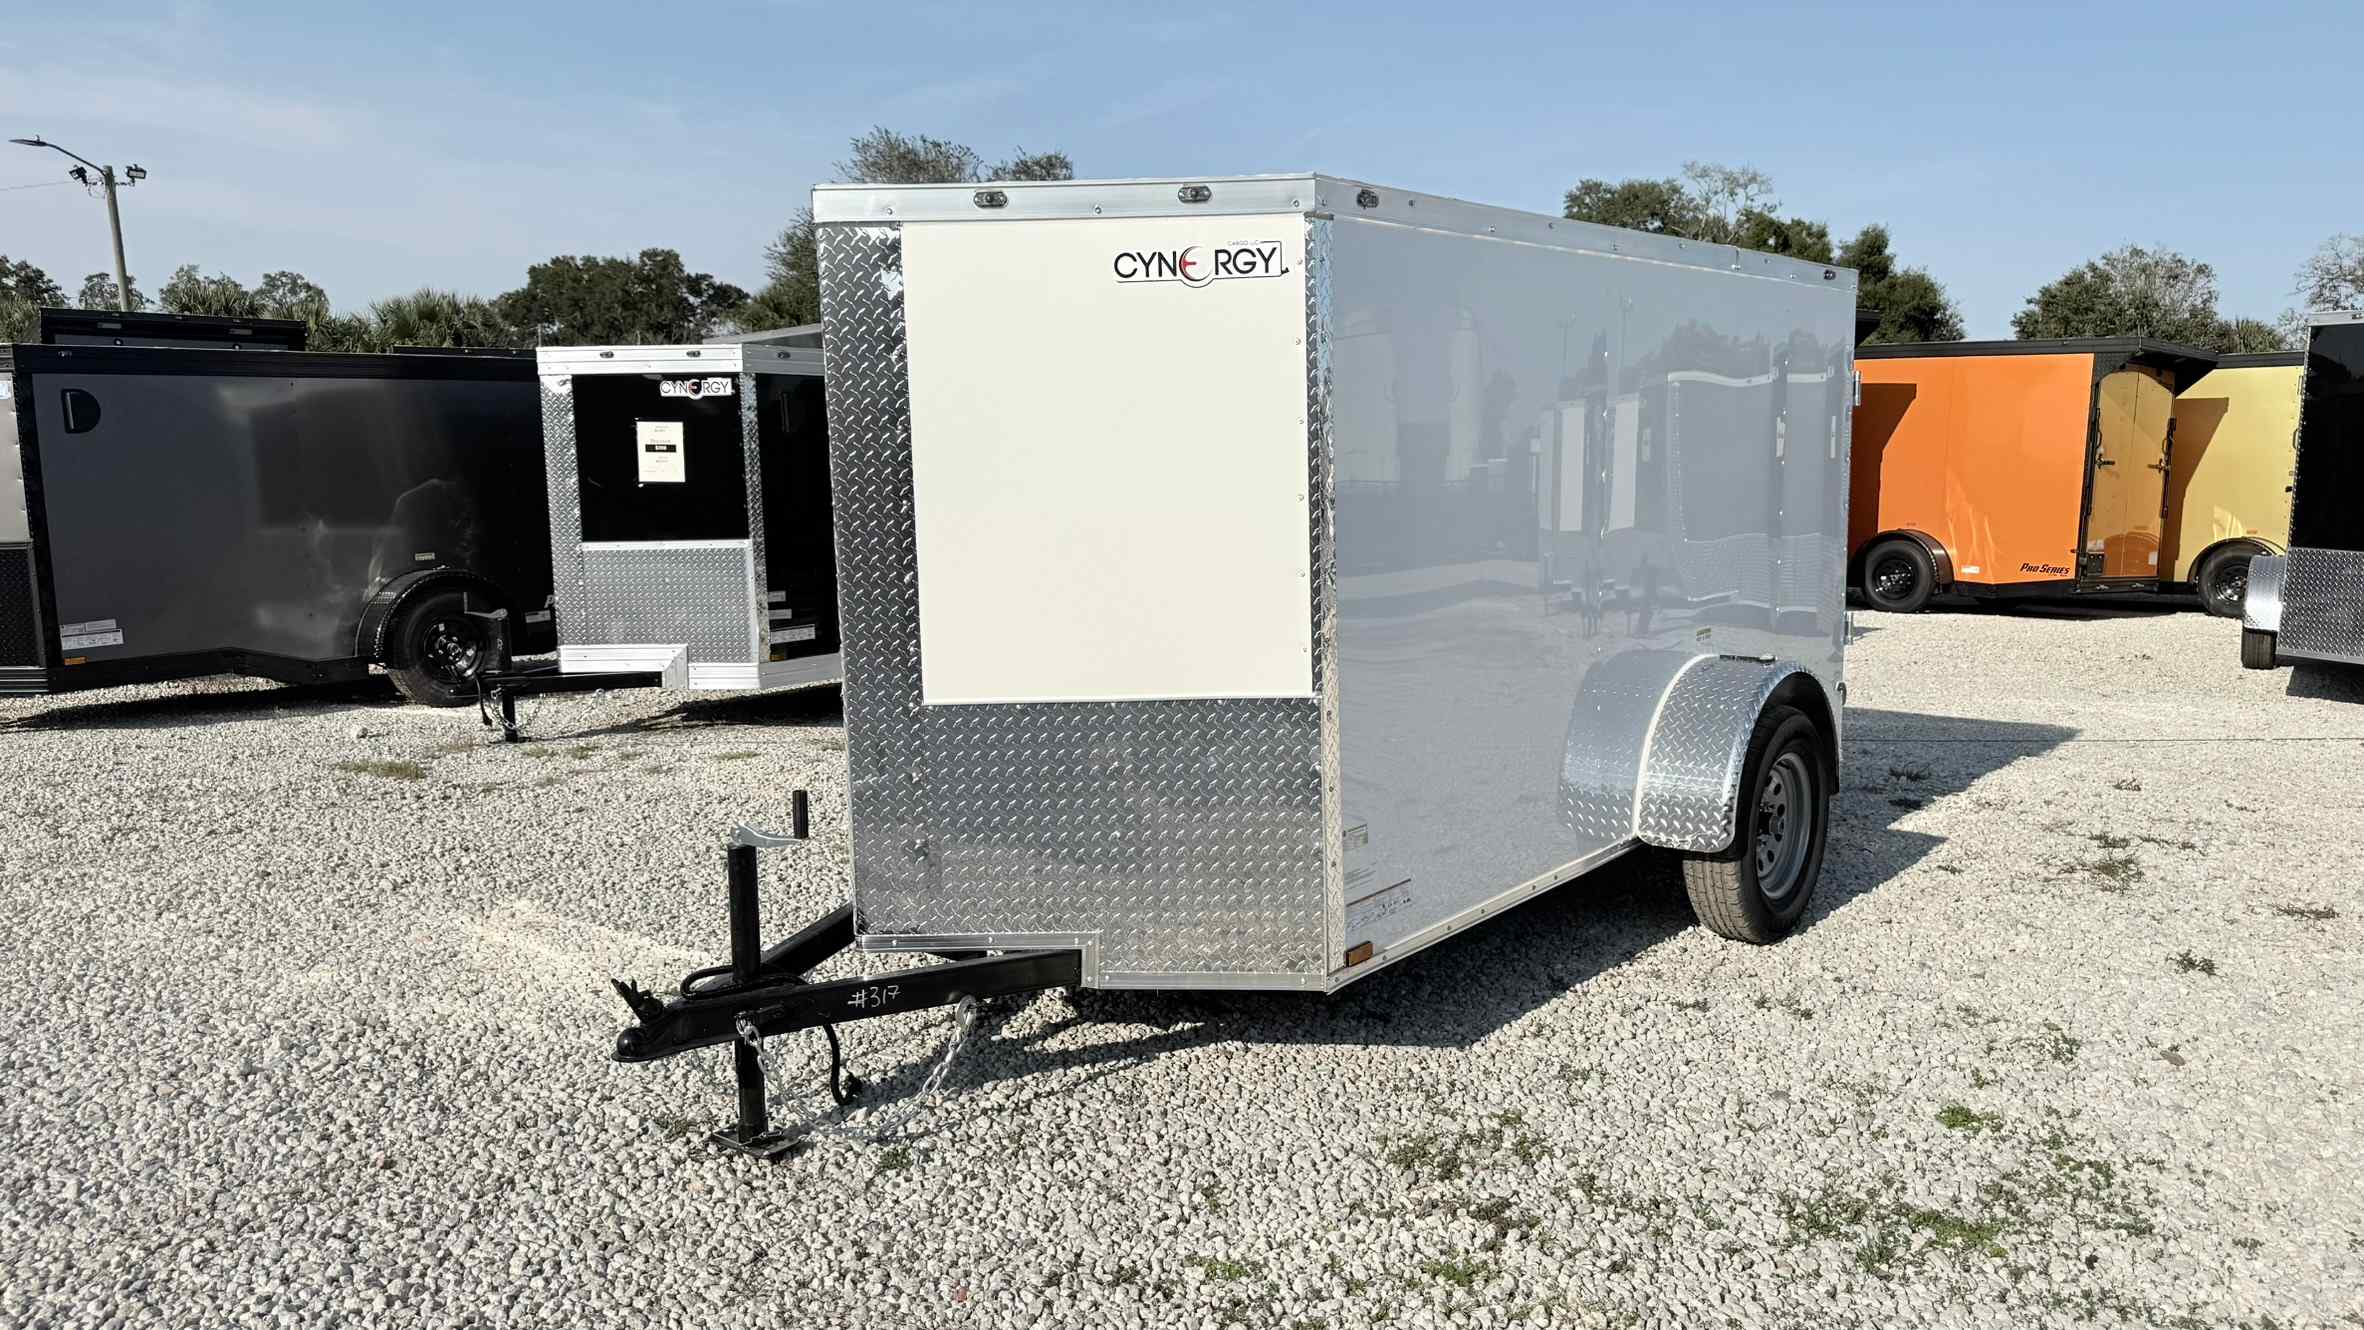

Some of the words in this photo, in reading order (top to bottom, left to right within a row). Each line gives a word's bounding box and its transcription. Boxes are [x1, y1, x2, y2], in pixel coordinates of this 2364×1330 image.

[1114, 246, 1277, 281] CYNERGY
[660, 380, 729, 397] CYNERGY
[848, 985, 900, 1008] #317
